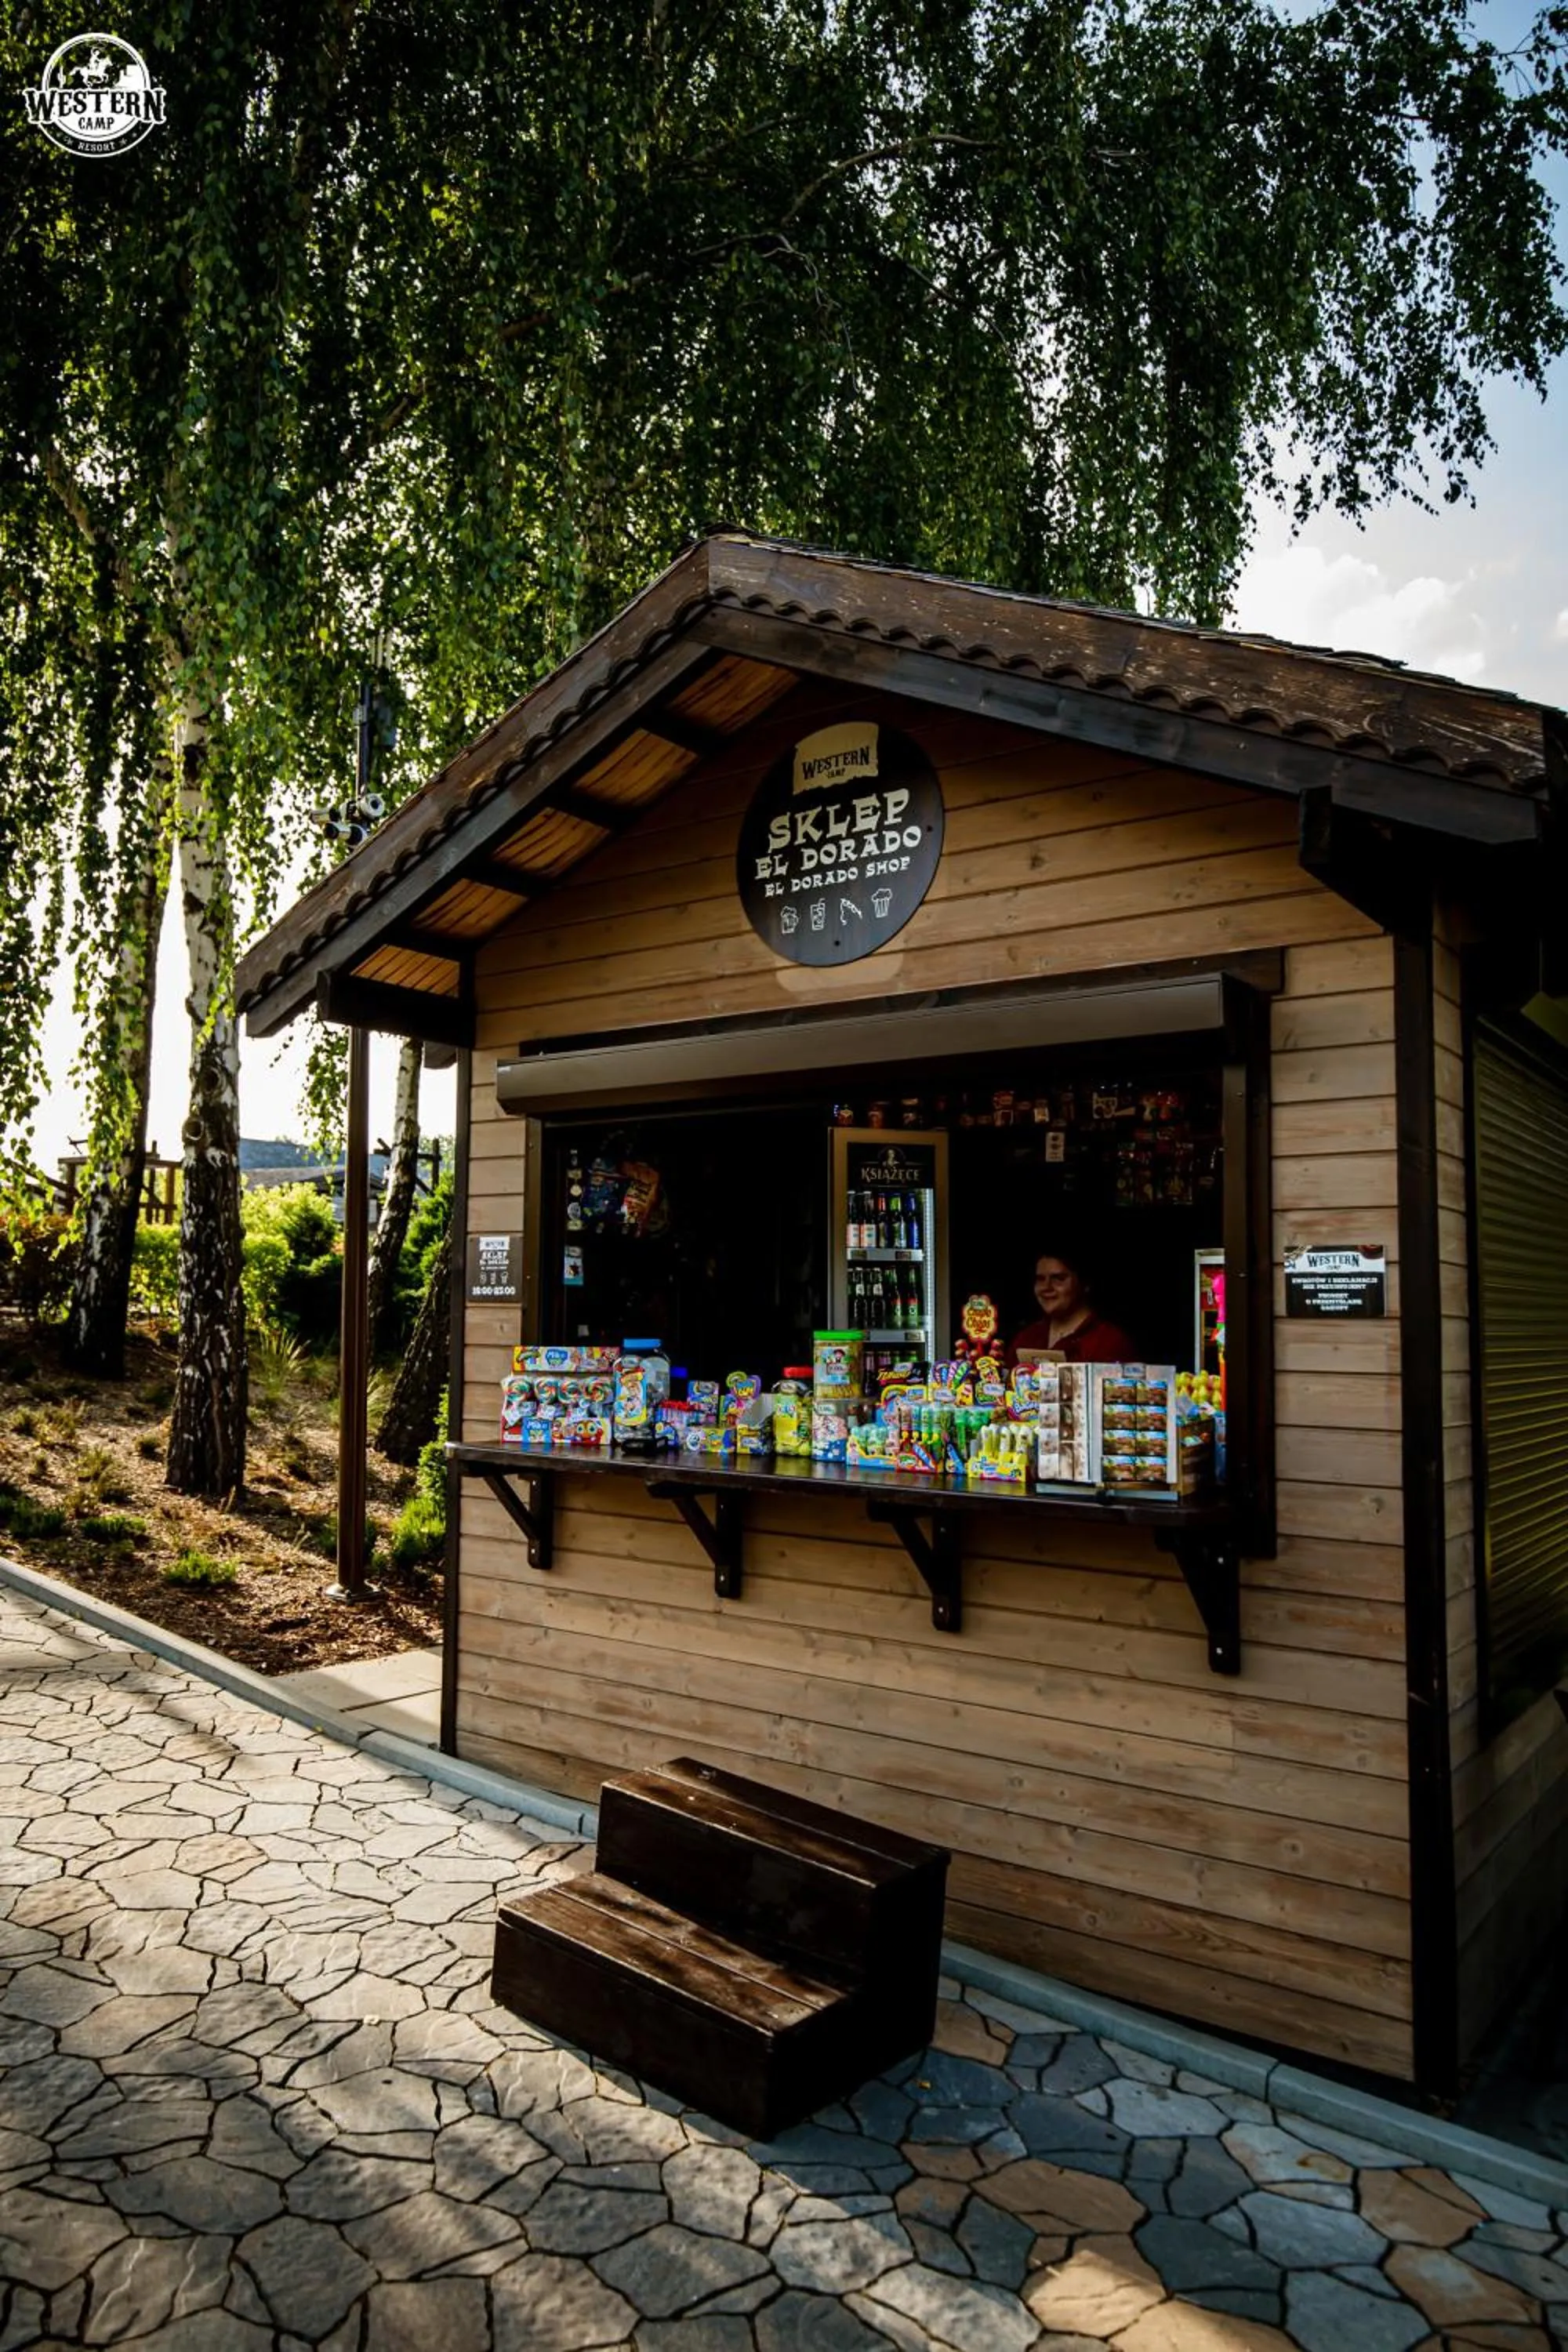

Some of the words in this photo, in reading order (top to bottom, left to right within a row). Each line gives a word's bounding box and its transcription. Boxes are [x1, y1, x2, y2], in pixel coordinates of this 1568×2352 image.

[802, 746, 869, 779] WESTERN
[768, 788, 910, 853] SKLEP
[755, 854, 789, 880] EL
[800, 826, 922, 870] DORADO
[765, 882, 784, 897] EL
[791, 867, 858, 892] DORADO
[866, 856, 910, 877] SHOP
[1307, 1254, 1360, 1268] WESTERN
